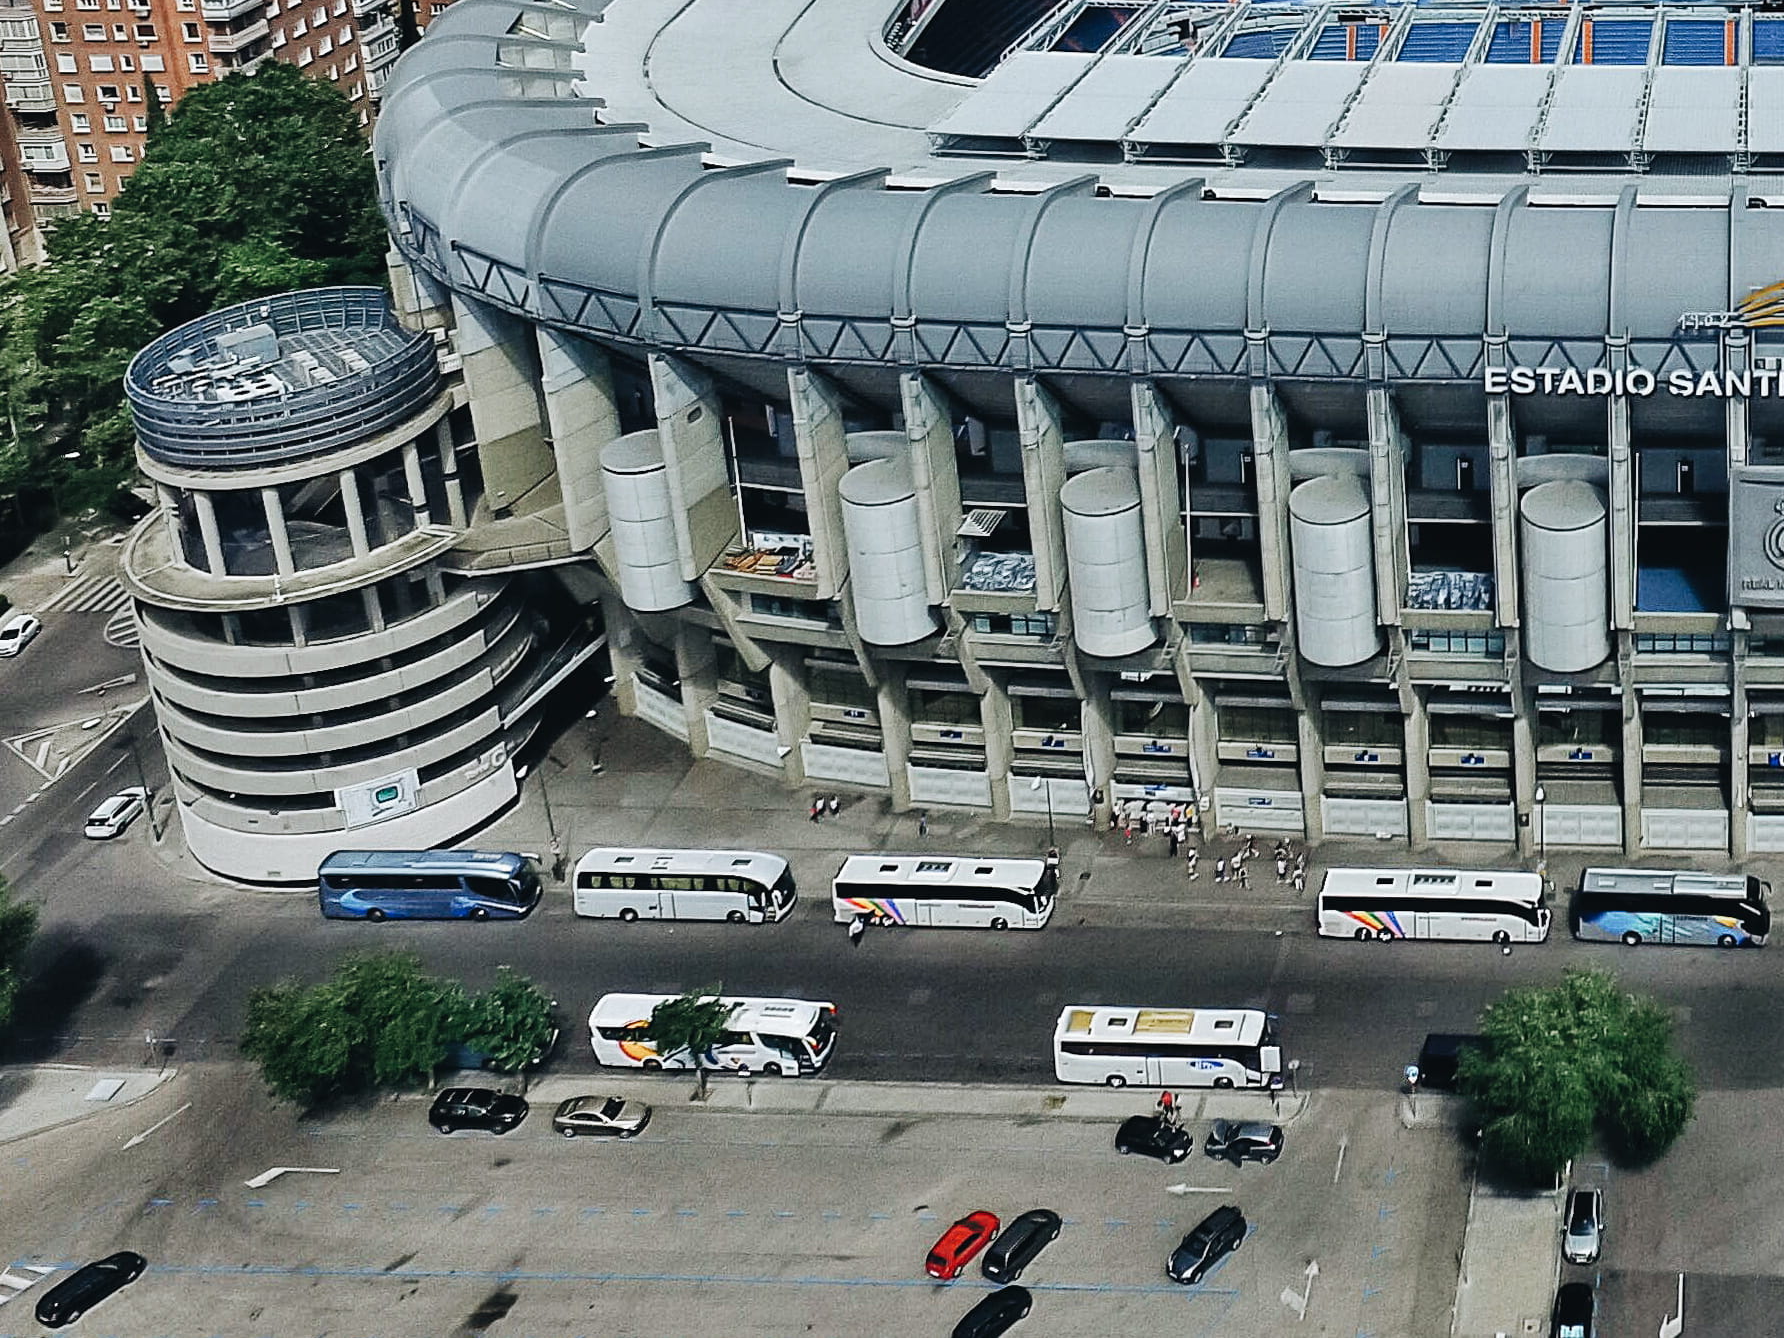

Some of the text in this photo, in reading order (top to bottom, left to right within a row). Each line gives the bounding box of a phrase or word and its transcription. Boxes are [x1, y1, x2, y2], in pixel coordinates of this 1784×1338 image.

[1677, 313, 1732, 329] 1902
[1484, 366, 1656, 396] ESTADIO
[1741, 578, 1774, 591] REAL
